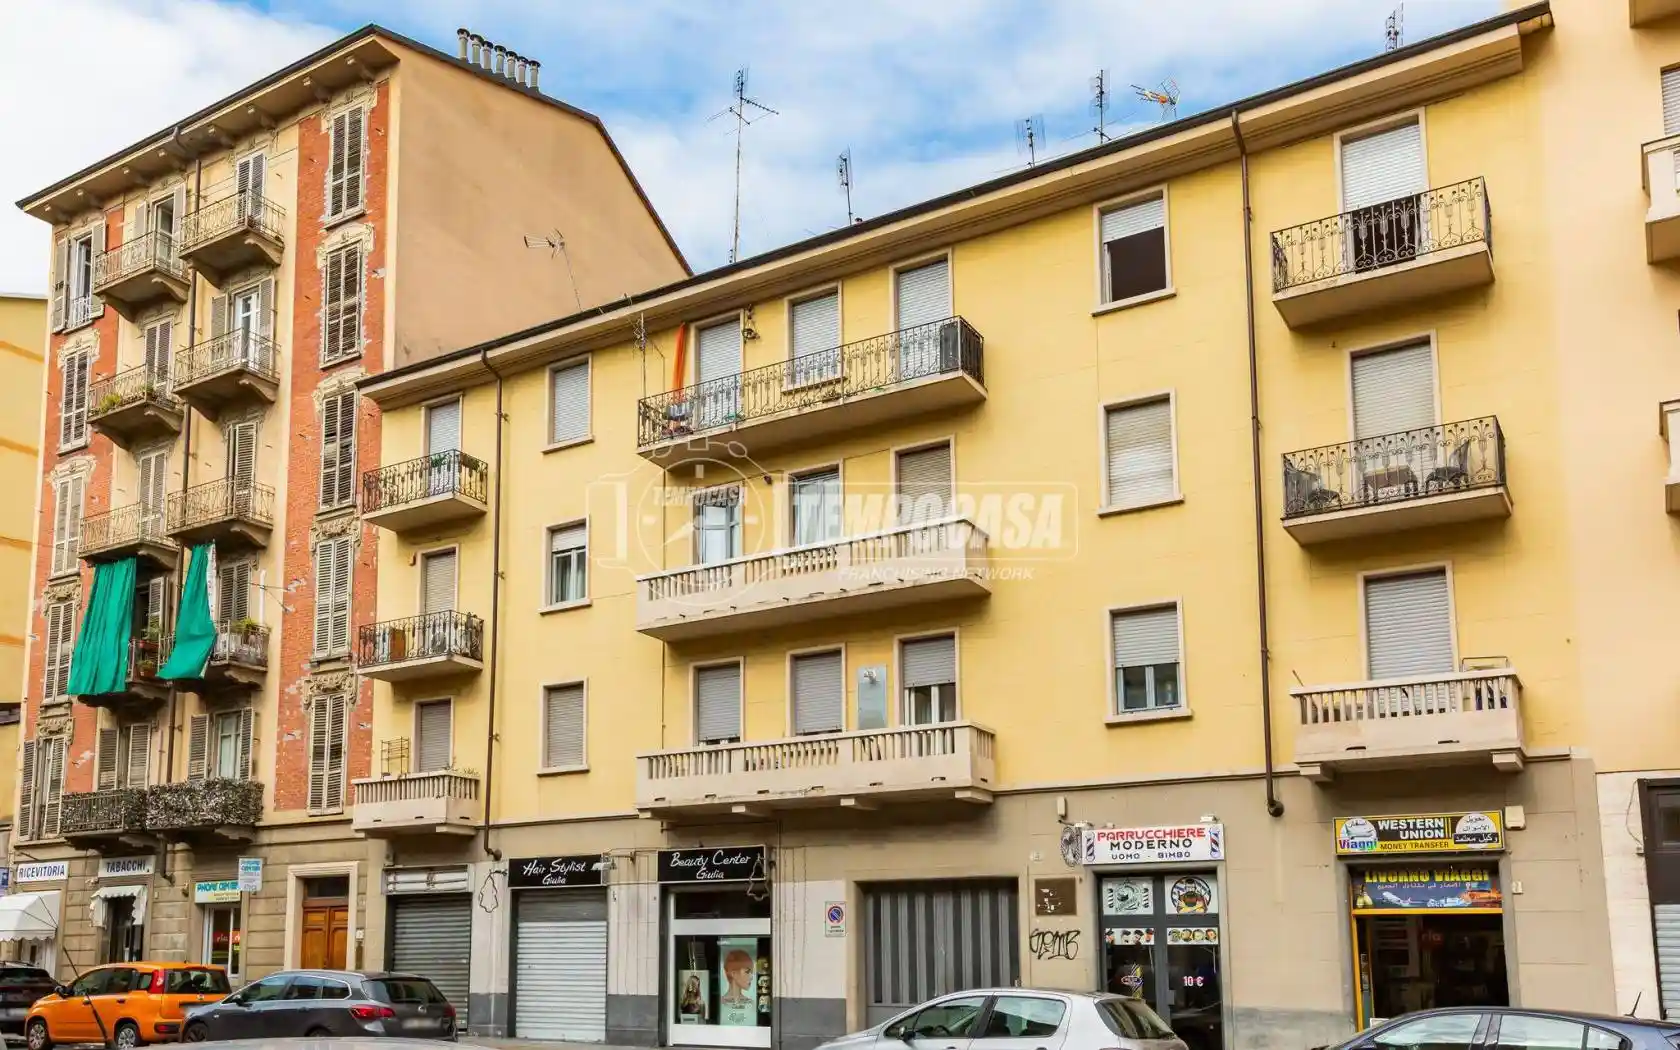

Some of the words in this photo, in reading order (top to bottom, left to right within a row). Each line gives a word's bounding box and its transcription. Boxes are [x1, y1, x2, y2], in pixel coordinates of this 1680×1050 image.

[1378, 818, 1444, 830] WESTERN
[1098, 827, 1206, 841] PARRUCCHIERE
[1400, 829, 1444, 840] UNION
[1110, 839, 1193, 851] MODERNO
[1339, 839, 1377, 850] Viaggi
[1380, 842, 1407, 850] MONEY
[1410, 841, 1449, 849] TRANSFER
[670, 852, 708, 868] Beauty
[712, 850, 751, 865] Center
[1158, 851, 1191, 859] BIMBO
[19, 865, 65, 878] RICEVITORIA
[107, 859, 146, 872] TABACCHI
[523, 860, 546, 876] Hair
[550, 858, 586, 874] Stylist
[542, 873, 567, 885] Giulia
[696, 867, 724, 879] Giulia
[1183, 976, 1194, 987] 10
